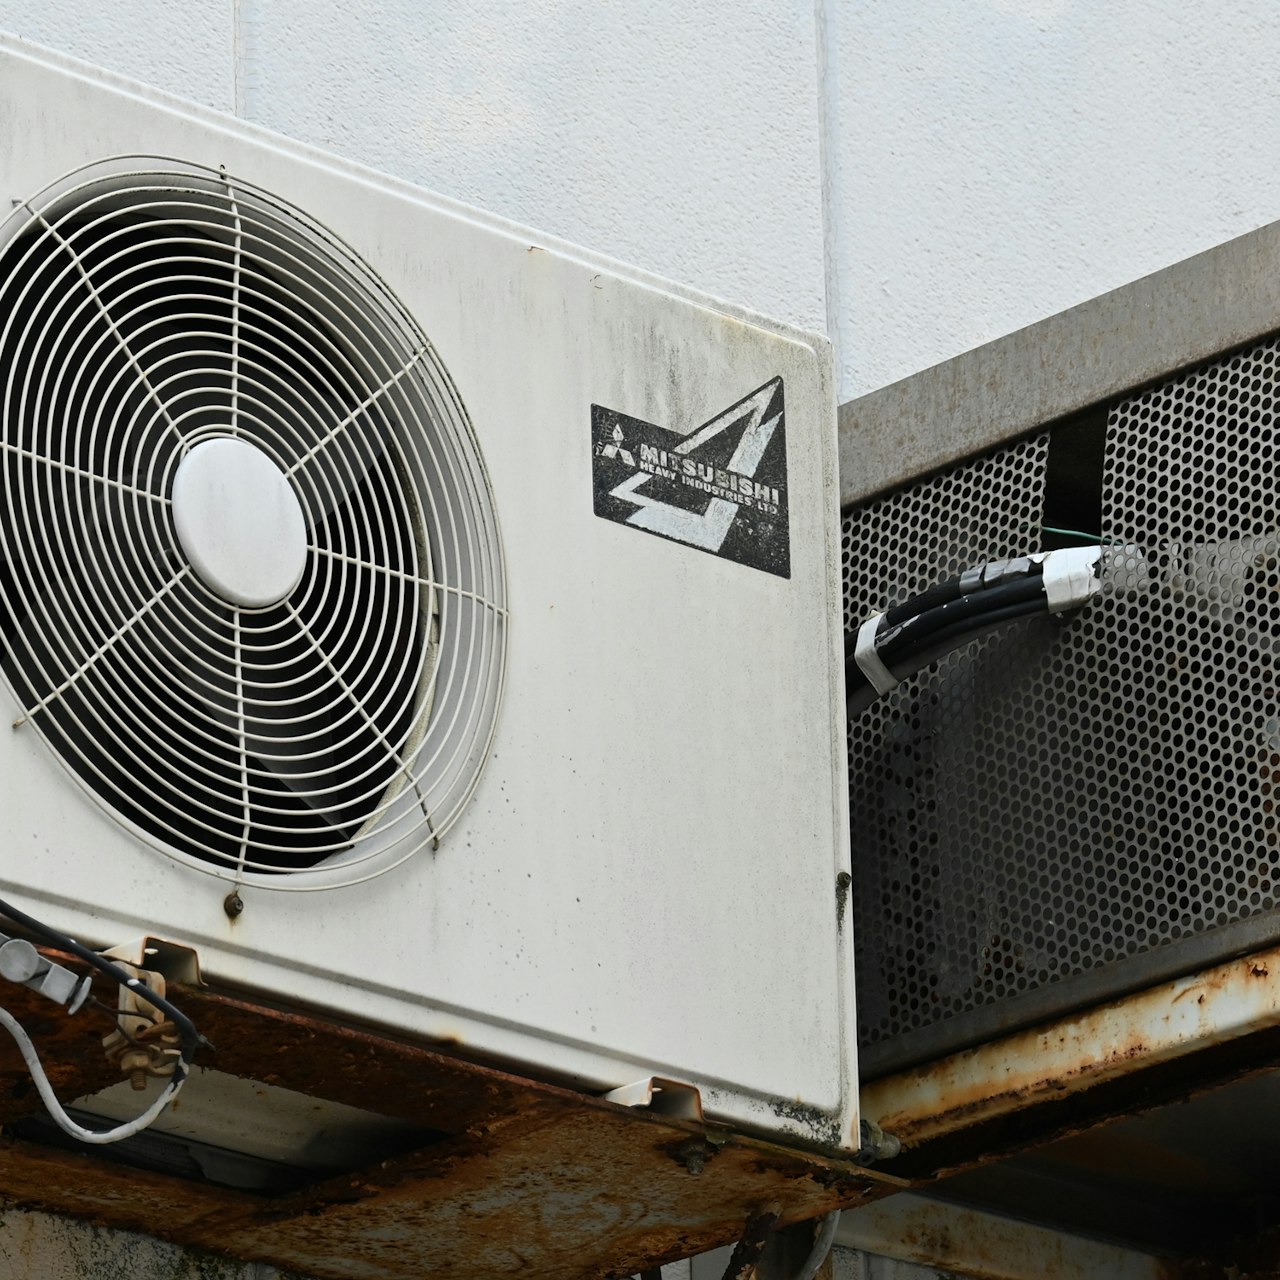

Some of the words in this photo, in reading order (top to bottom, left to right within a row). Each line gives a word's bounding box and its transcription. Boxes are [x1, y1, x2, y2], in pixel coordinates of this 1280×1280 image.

[640, 443, 779, 505] MITSUBISHI
[640, 460, 676, 481] HEAVY
[682, 475, 753, 507] INDUSTRIES
